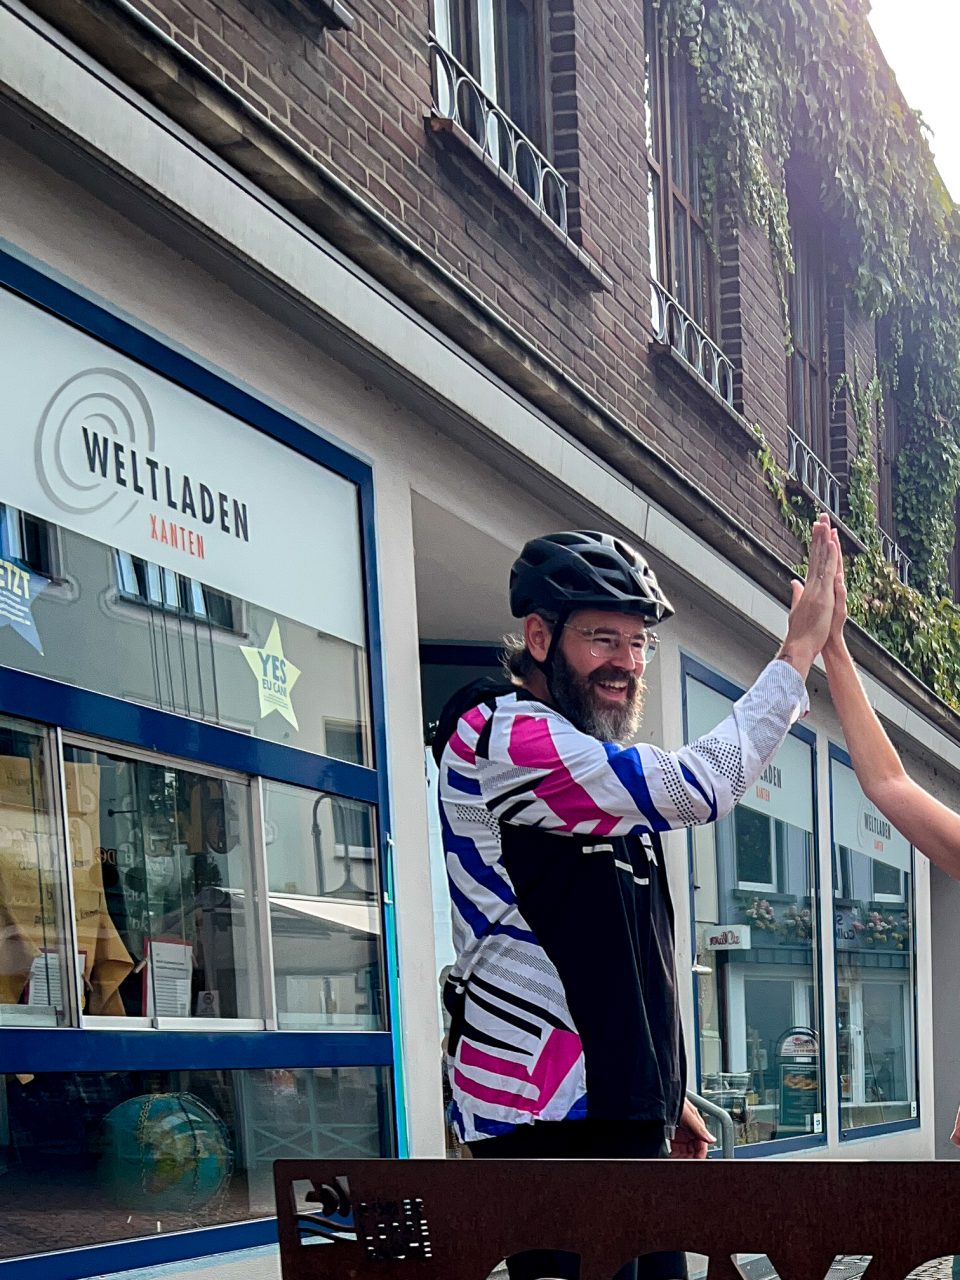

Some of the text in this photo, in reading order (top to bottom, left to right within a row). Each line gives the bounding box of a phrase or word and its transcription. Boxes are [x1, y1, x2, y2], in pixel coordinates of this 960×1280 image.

[82, 425, 249, 542] WELTLADEN
[150, 513, 205, 560] XANTEN
[258, 650, 287, 685] YES
[262, 678, 272, 690] EU
[760, 764, 782, 789] ADEN
[864, 812, 891, 841] WELTLADEN
